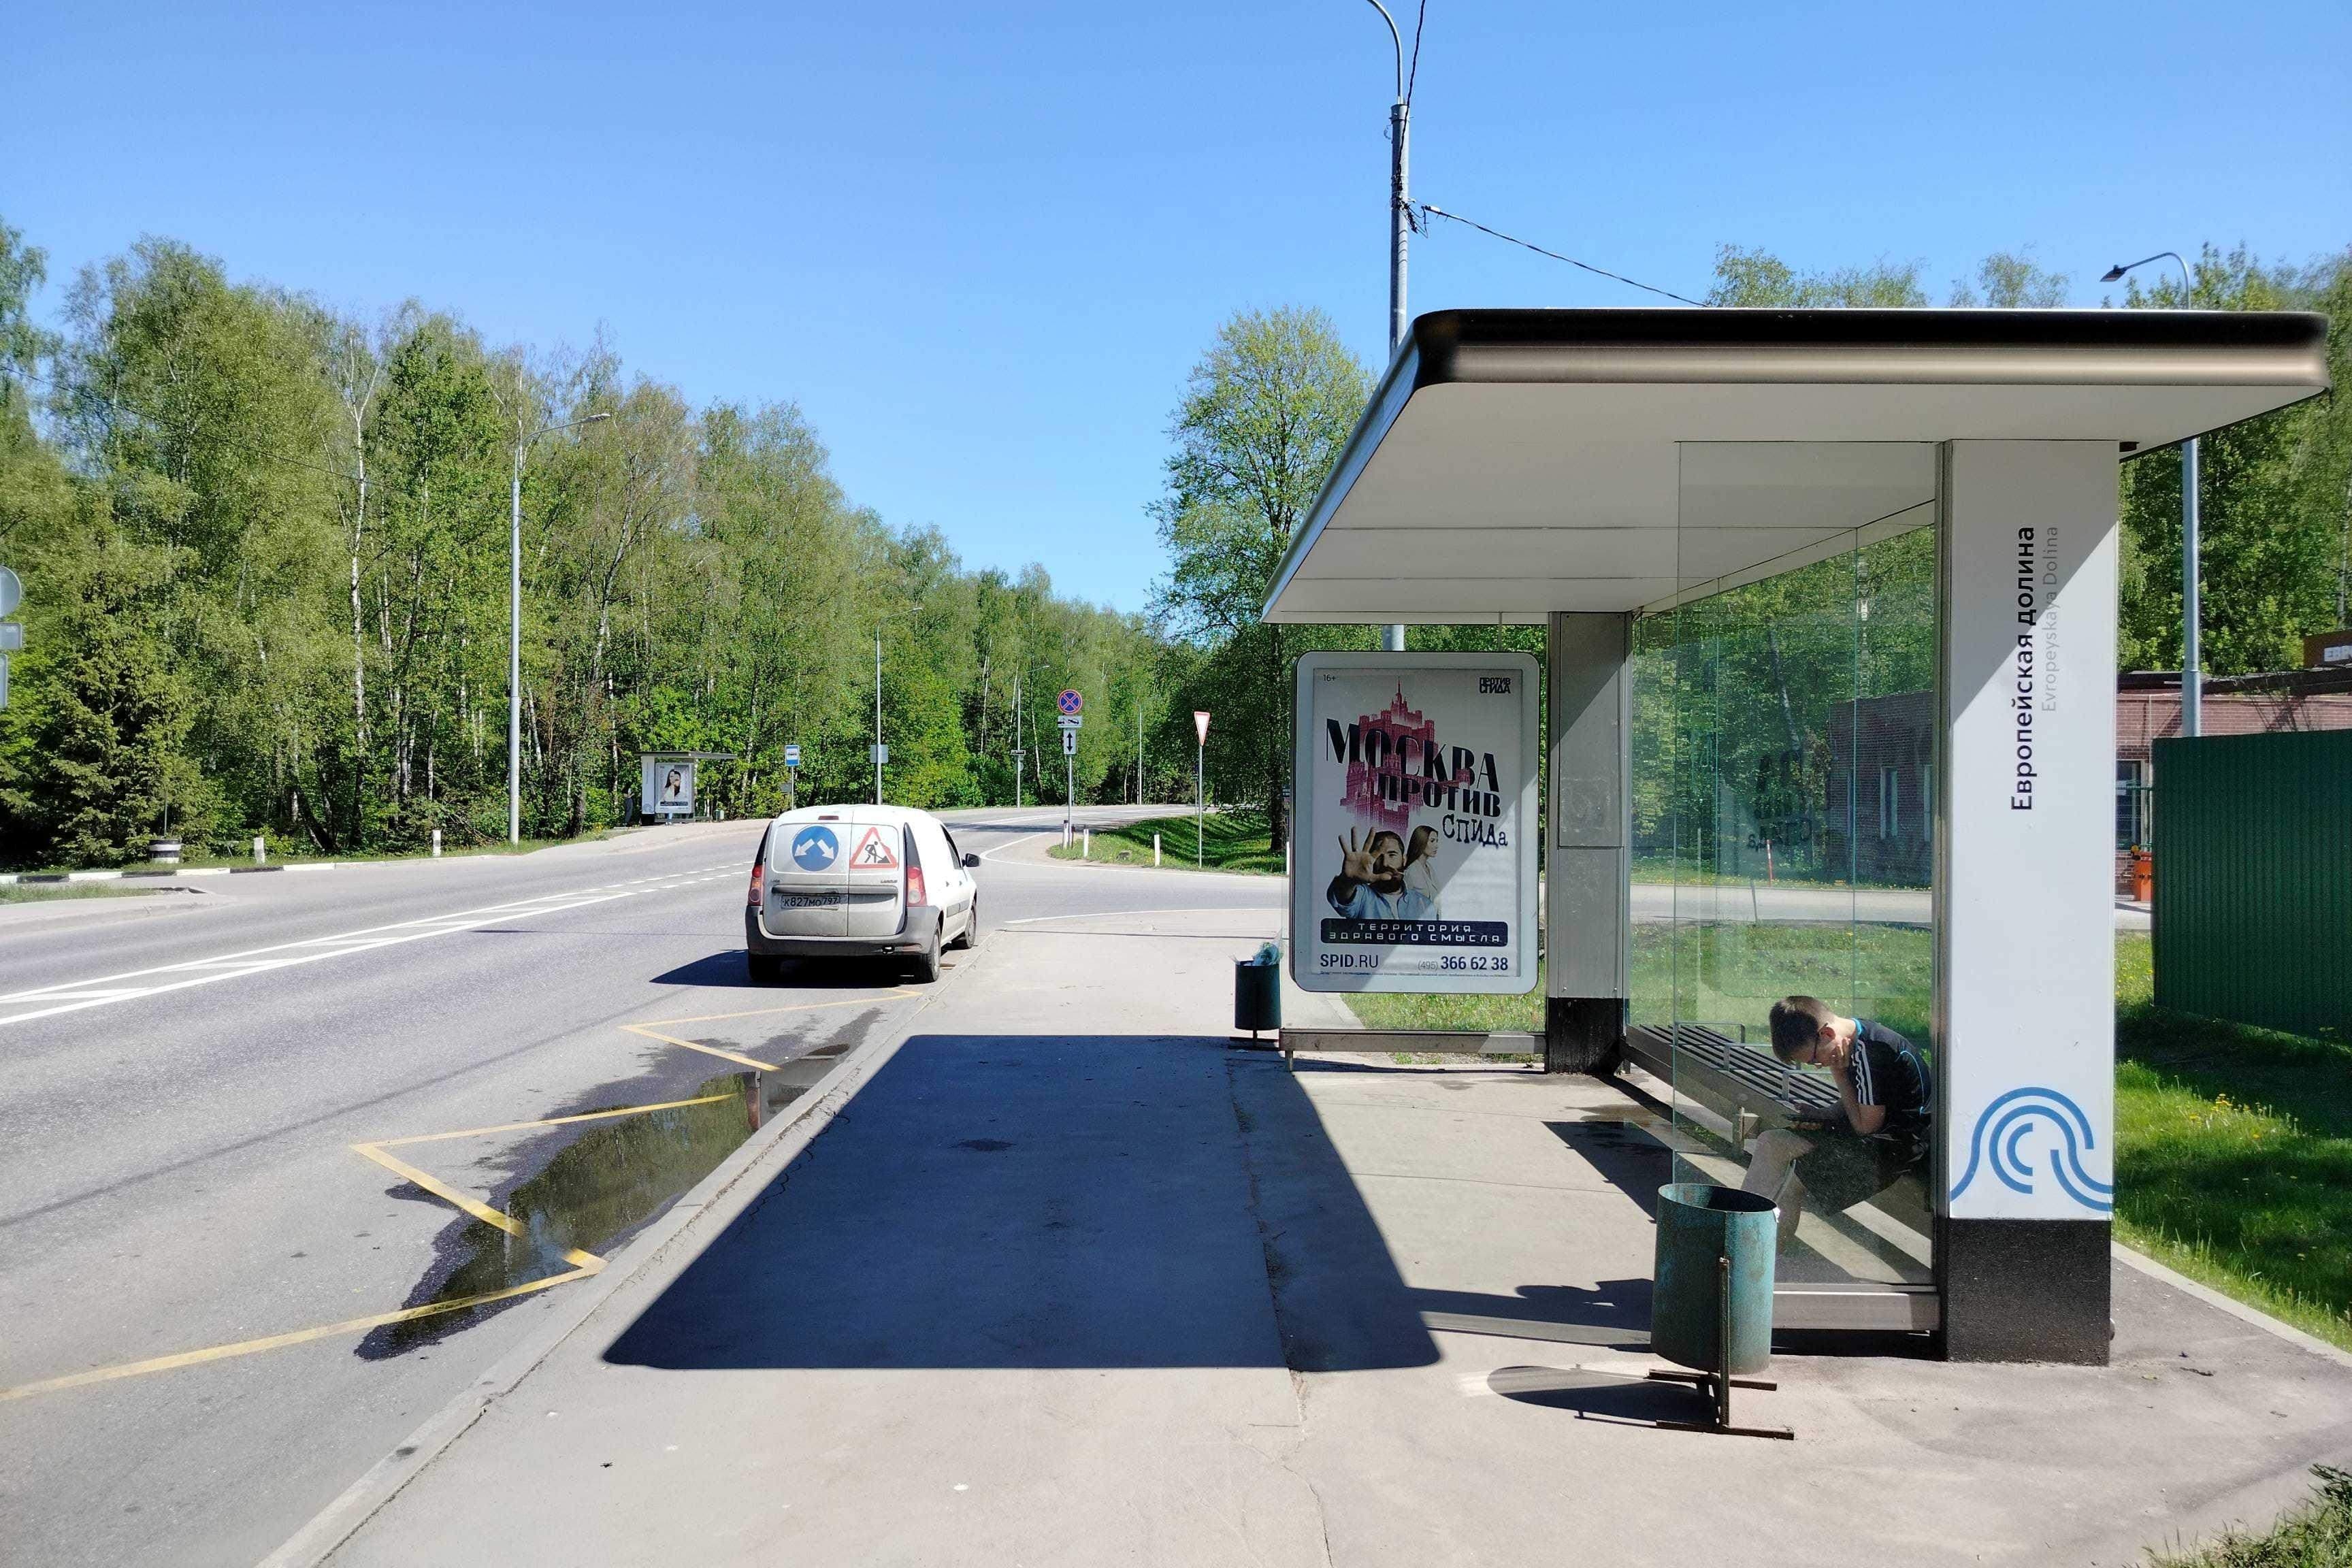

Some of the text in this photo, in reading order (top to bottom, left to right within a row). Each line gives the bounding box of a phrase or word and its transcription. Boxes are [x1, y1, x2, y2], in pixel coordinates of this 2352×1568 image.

[2042, 526, 2061, 712] Evropeyskaya Dolina
[2010, 527, 2037, 810] Европейская долина
[1326, 718, 1499, 792] МОСКВА
[1376, 772, 1501, 817] ПРОТИВ
[1329, 932, 1500, 943] ЗДРАВОГО СМЫСЛА
[1358, 923, 1471, 933] ТЕРРИТОРИЯ
[1320, 954, 1378, 968] SPID.RU
[1418, 956, 1508, 970] (495) 366 62 38
